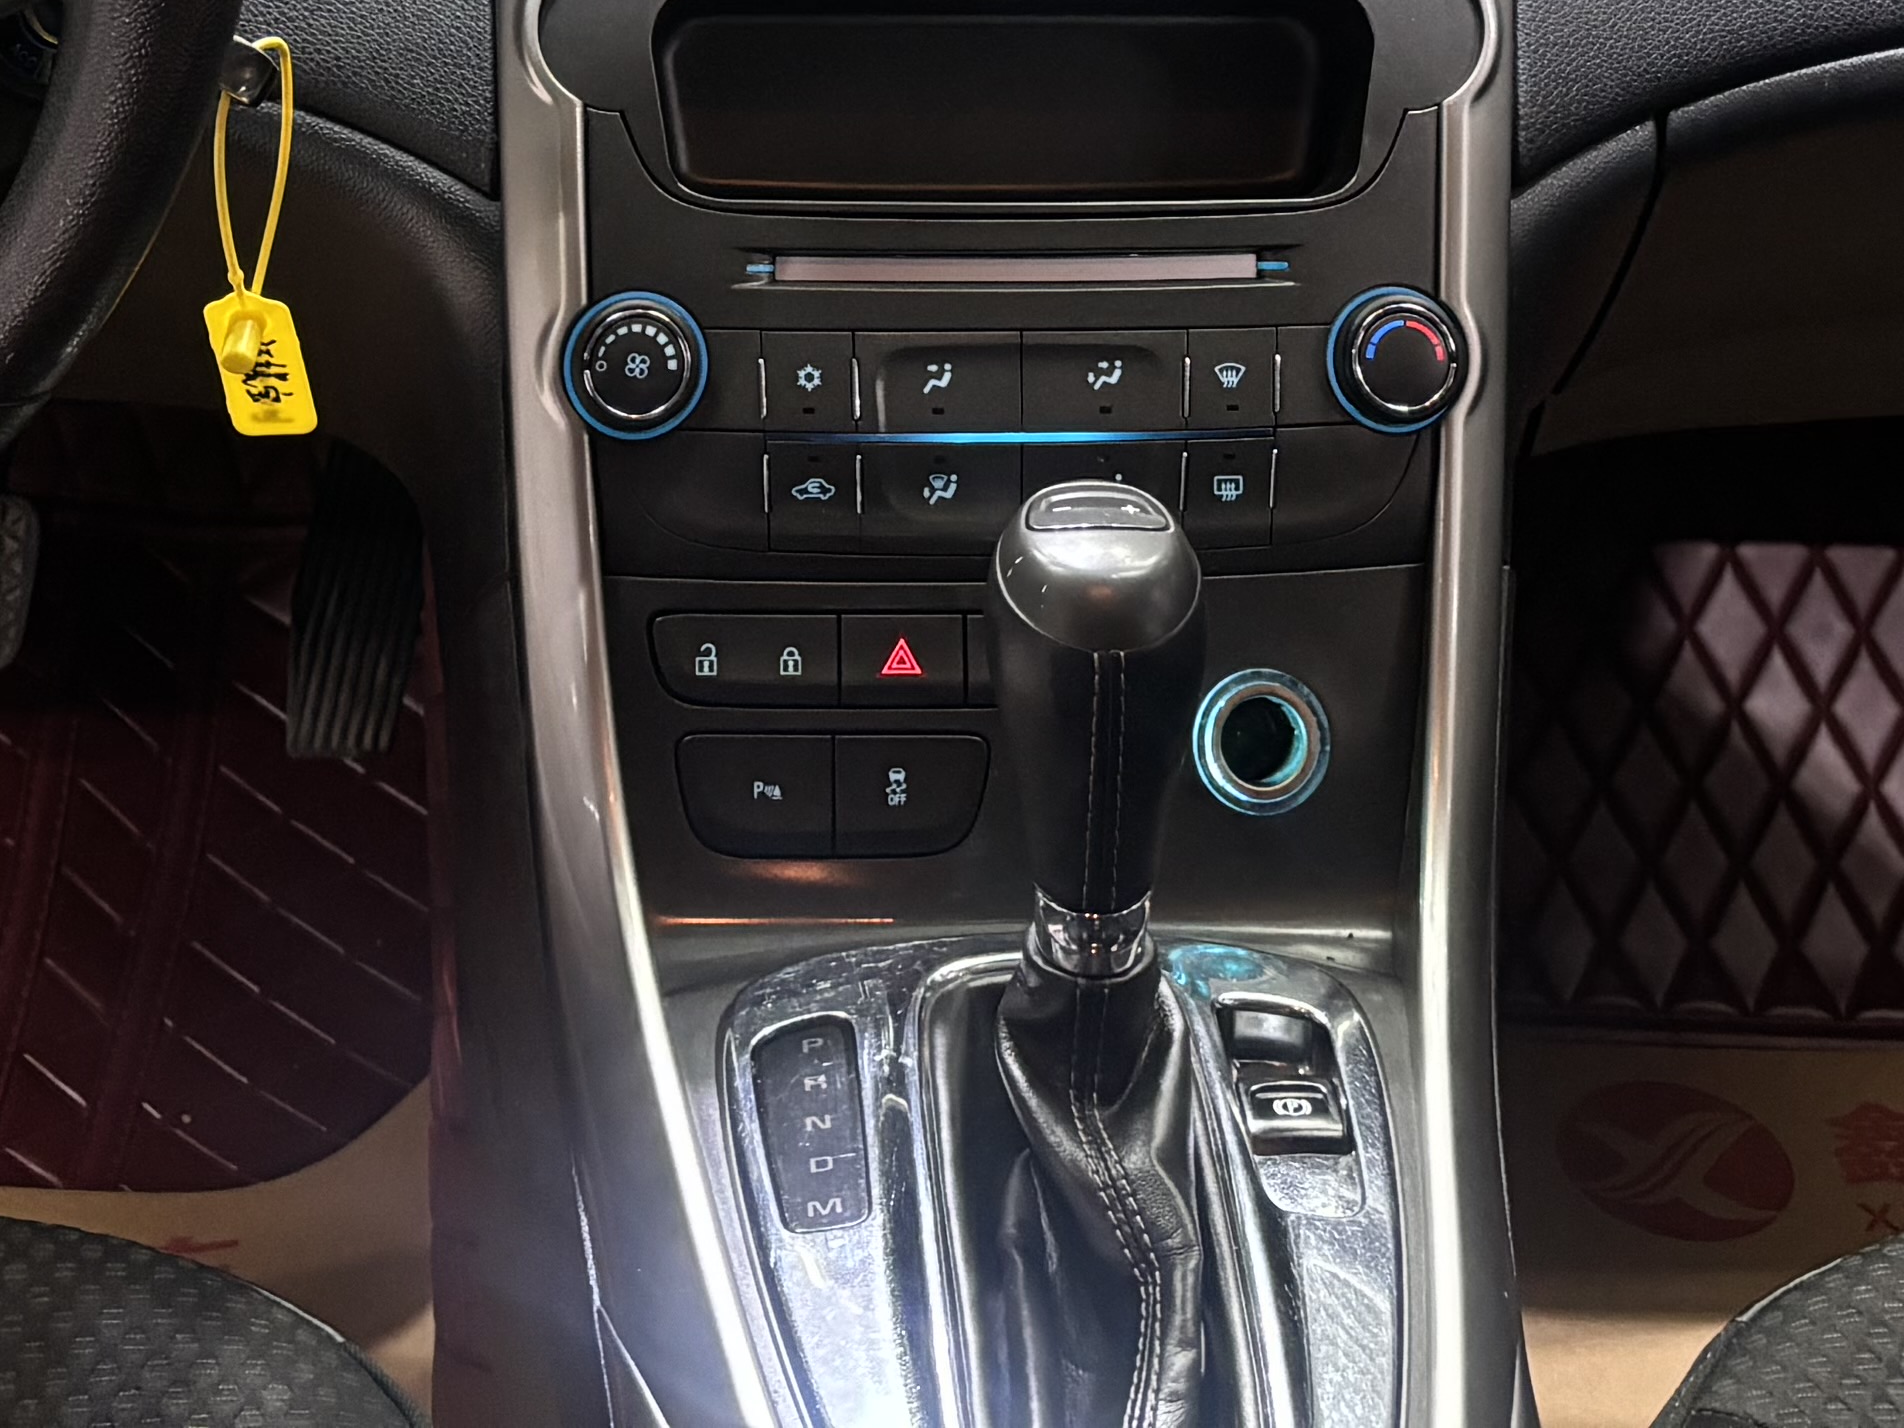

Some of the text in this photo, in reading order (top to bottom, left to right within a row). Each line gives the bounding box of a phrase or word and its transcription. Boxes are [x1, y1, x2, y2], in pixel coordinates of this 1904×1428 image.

[887, 794, 907, 806] OFF
[802, 1037, 824, 1054] P
[804, 1074, 827, 1092] R
[805, 1114, 832, 1132] N
[809, 1156, 834, 1174] D
[807, 1197, 843, 1218] M
